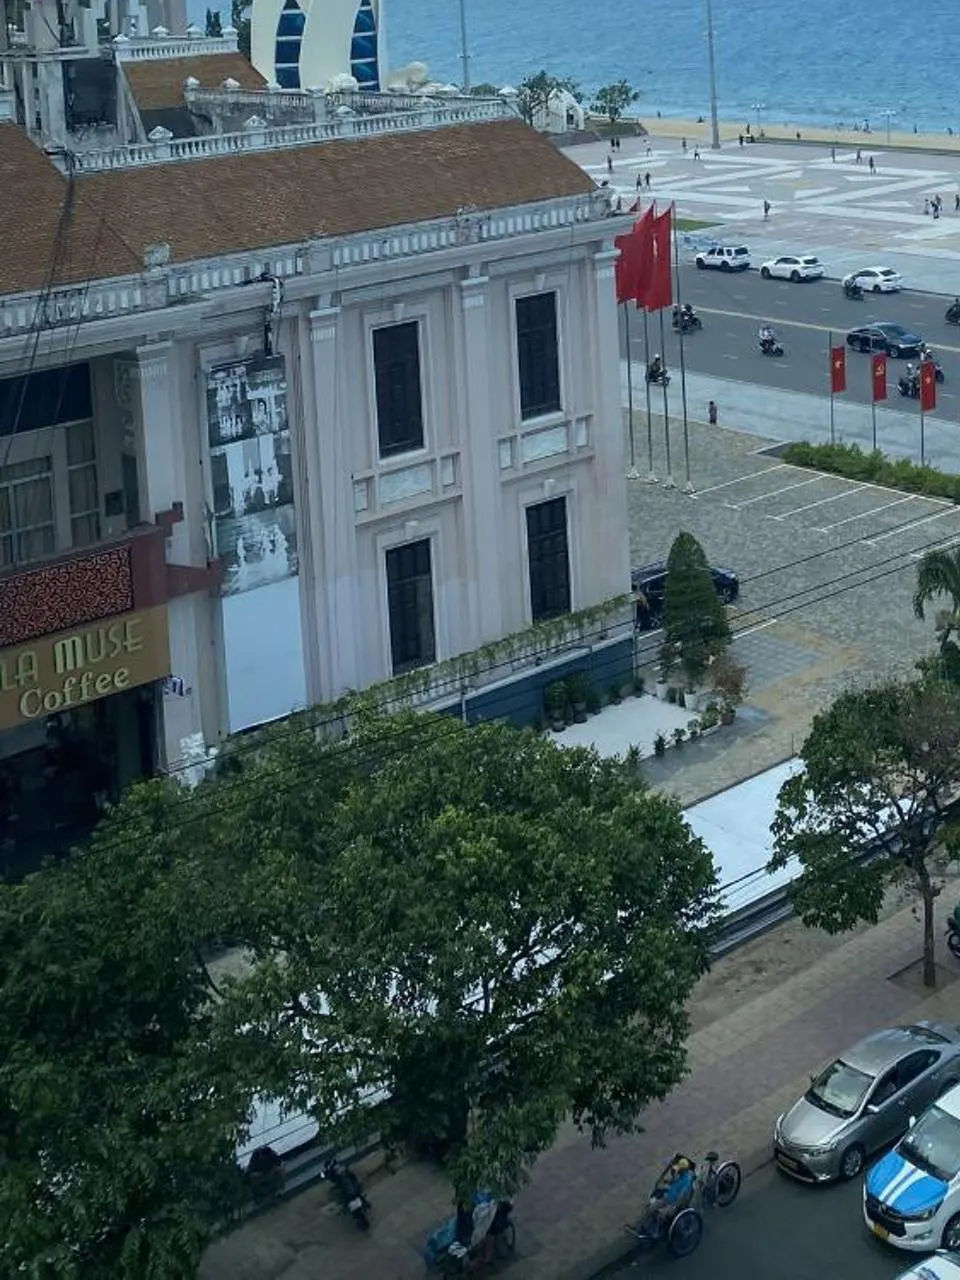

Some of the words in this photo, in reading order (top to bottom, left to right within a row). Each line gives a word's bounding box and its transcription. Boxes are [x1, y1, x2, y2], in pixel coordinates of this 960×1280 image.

[1, 651, 38, 690] LA
[54, 619, 143, 675] MUSE
[20, 667, 130, 718] Coffee
